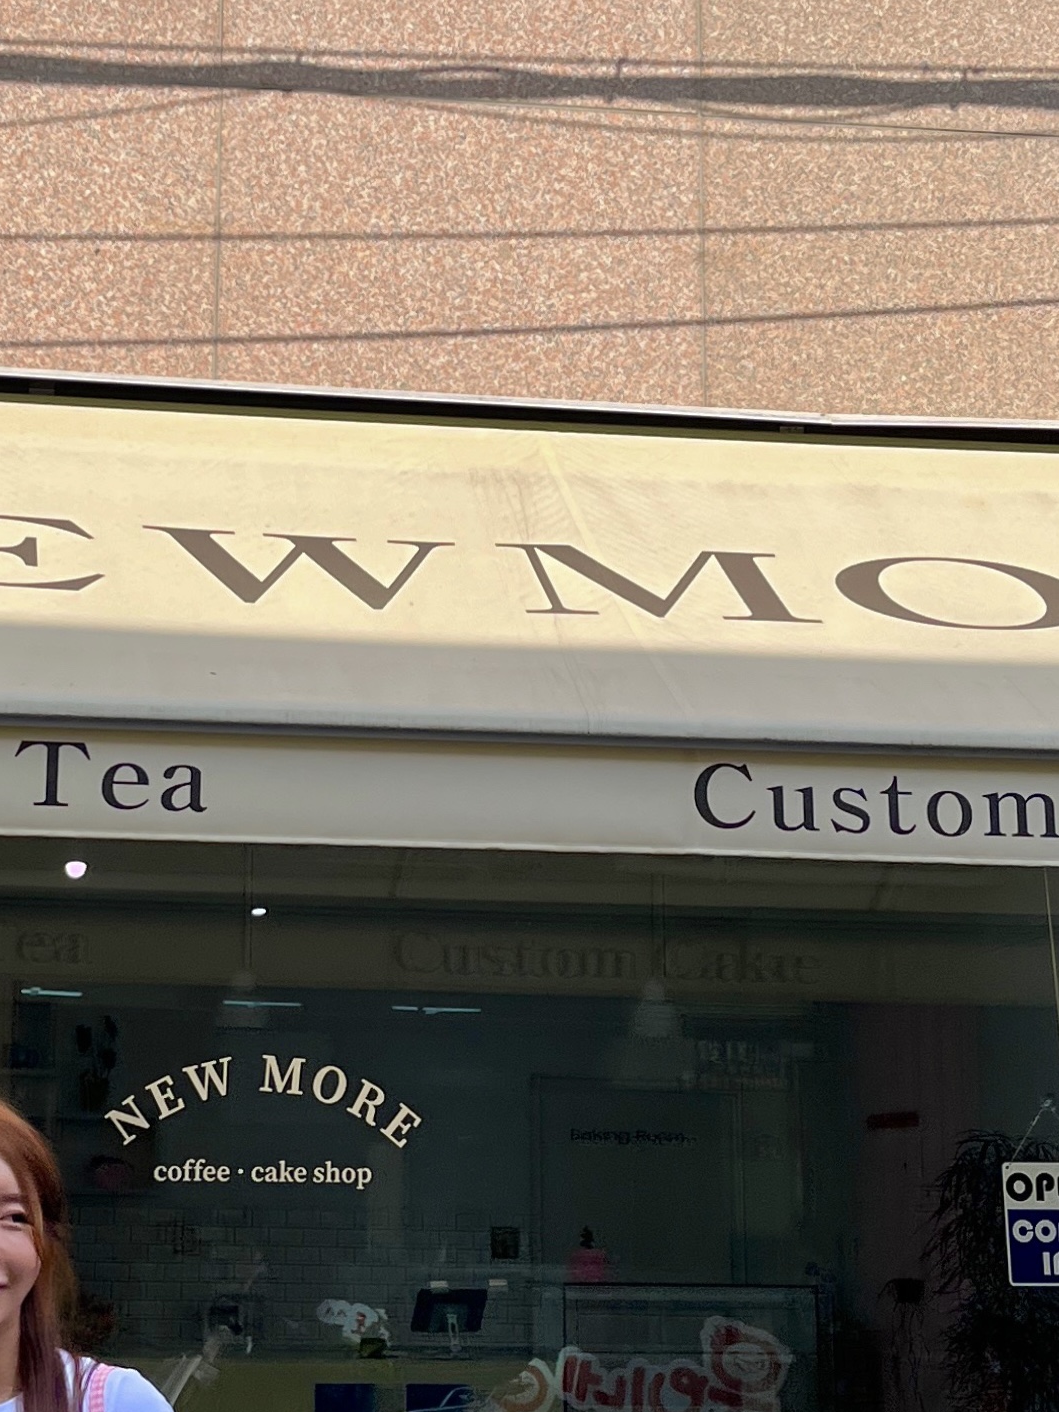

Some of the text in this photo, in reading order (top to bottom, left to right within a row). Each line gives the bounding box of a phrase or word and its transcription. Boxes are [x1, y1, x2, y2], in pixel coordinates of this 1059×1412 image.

[14, 739, 208, 813] Tea
[104, 1054, 422, 1149] NEW MORE
[153, 1158, 373, 1190] coffee cake shop
